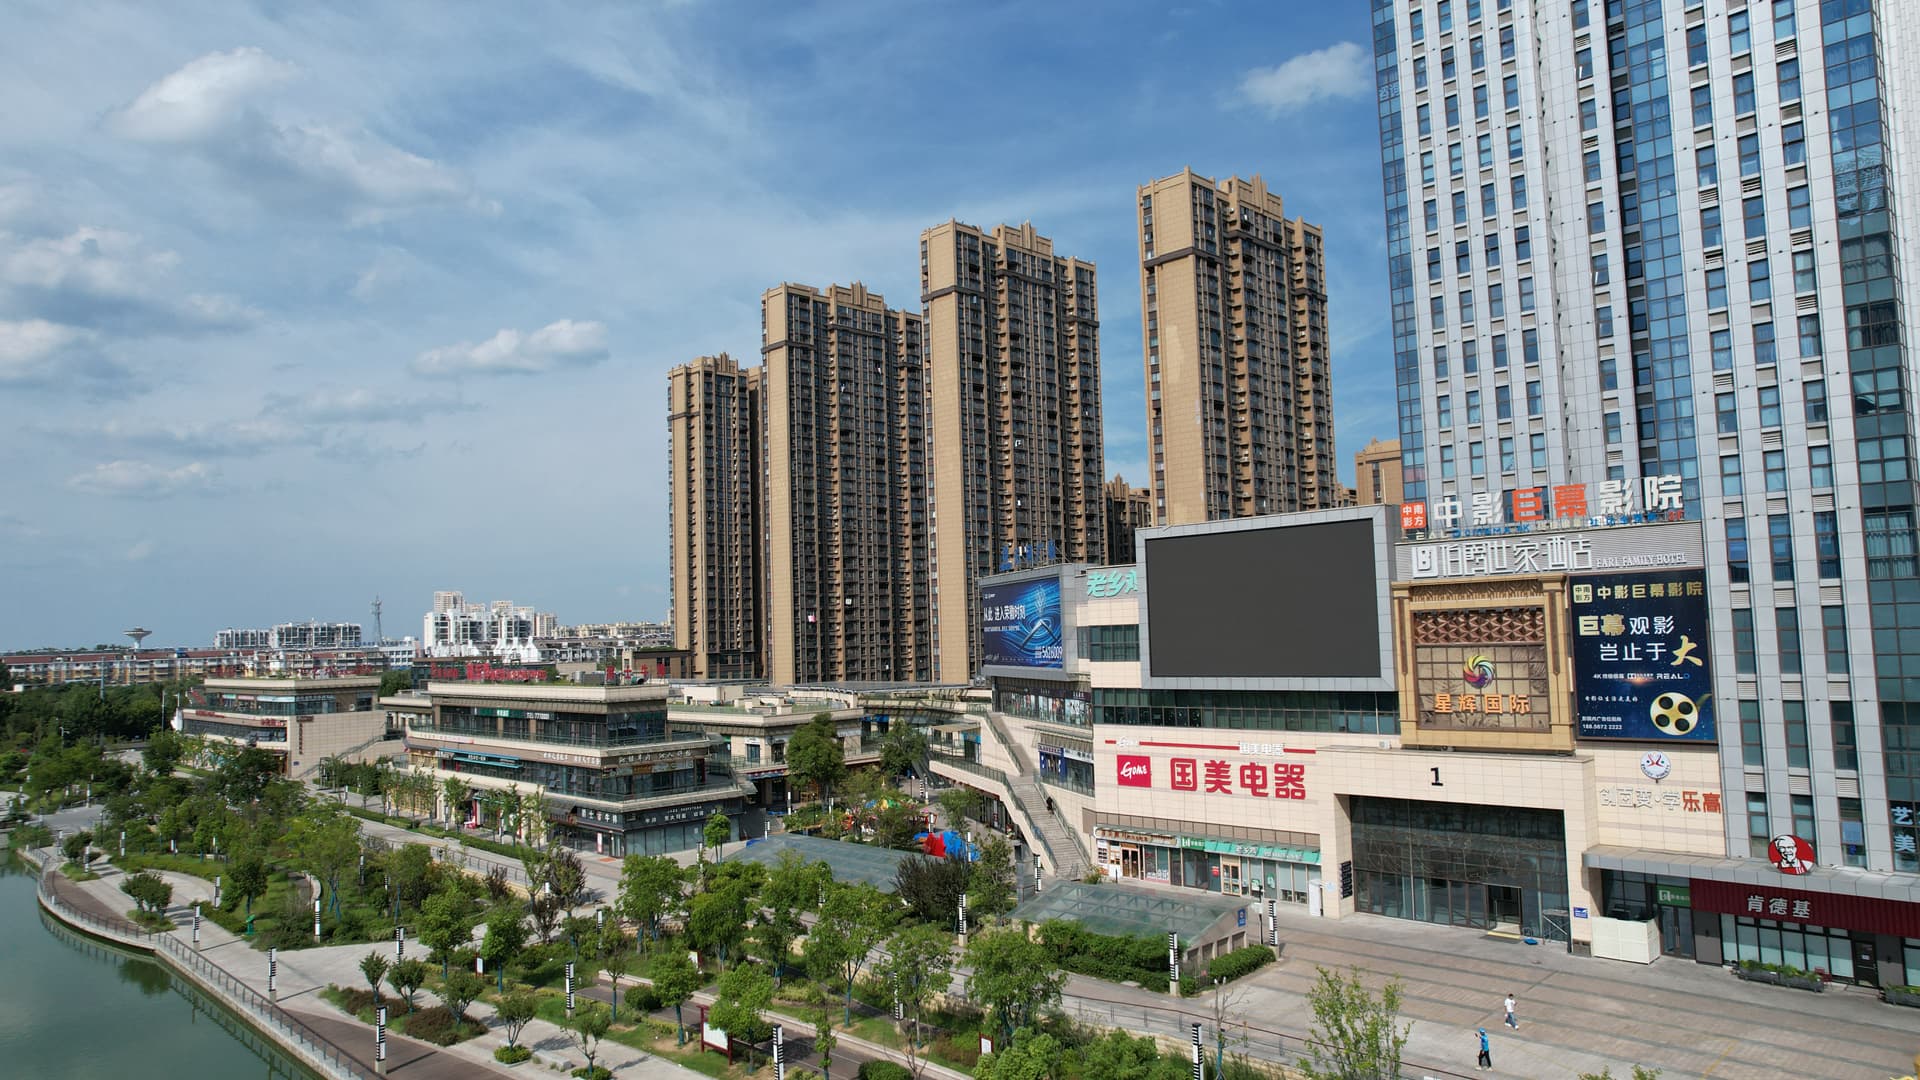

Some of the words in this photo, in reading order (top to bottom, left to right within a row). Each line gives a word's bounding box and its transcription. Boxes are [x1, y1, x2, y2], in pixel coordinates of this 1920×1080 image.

[1434, 475, 1684, 528] 中影巨幕影院
[1439, 535, 1593, 577] 伯爵世家酒店
[1596, 557, 1618, 568] EARL
[1622, 554, 1654, 566] FAMILY
[1657, 552, 1687, 564] HOTEL
[1597, 581, 1704, 600] 中影巨幕影院
[1600, 635, 1703, 667] 岂止于大
[1434, 693, 1531, 714] 星辉国际
[1170, 757, 1306, 800] 国美电器
[1430, 766, 1444, 787] 1
[1747, 894, 1812, 919] 肯德基
